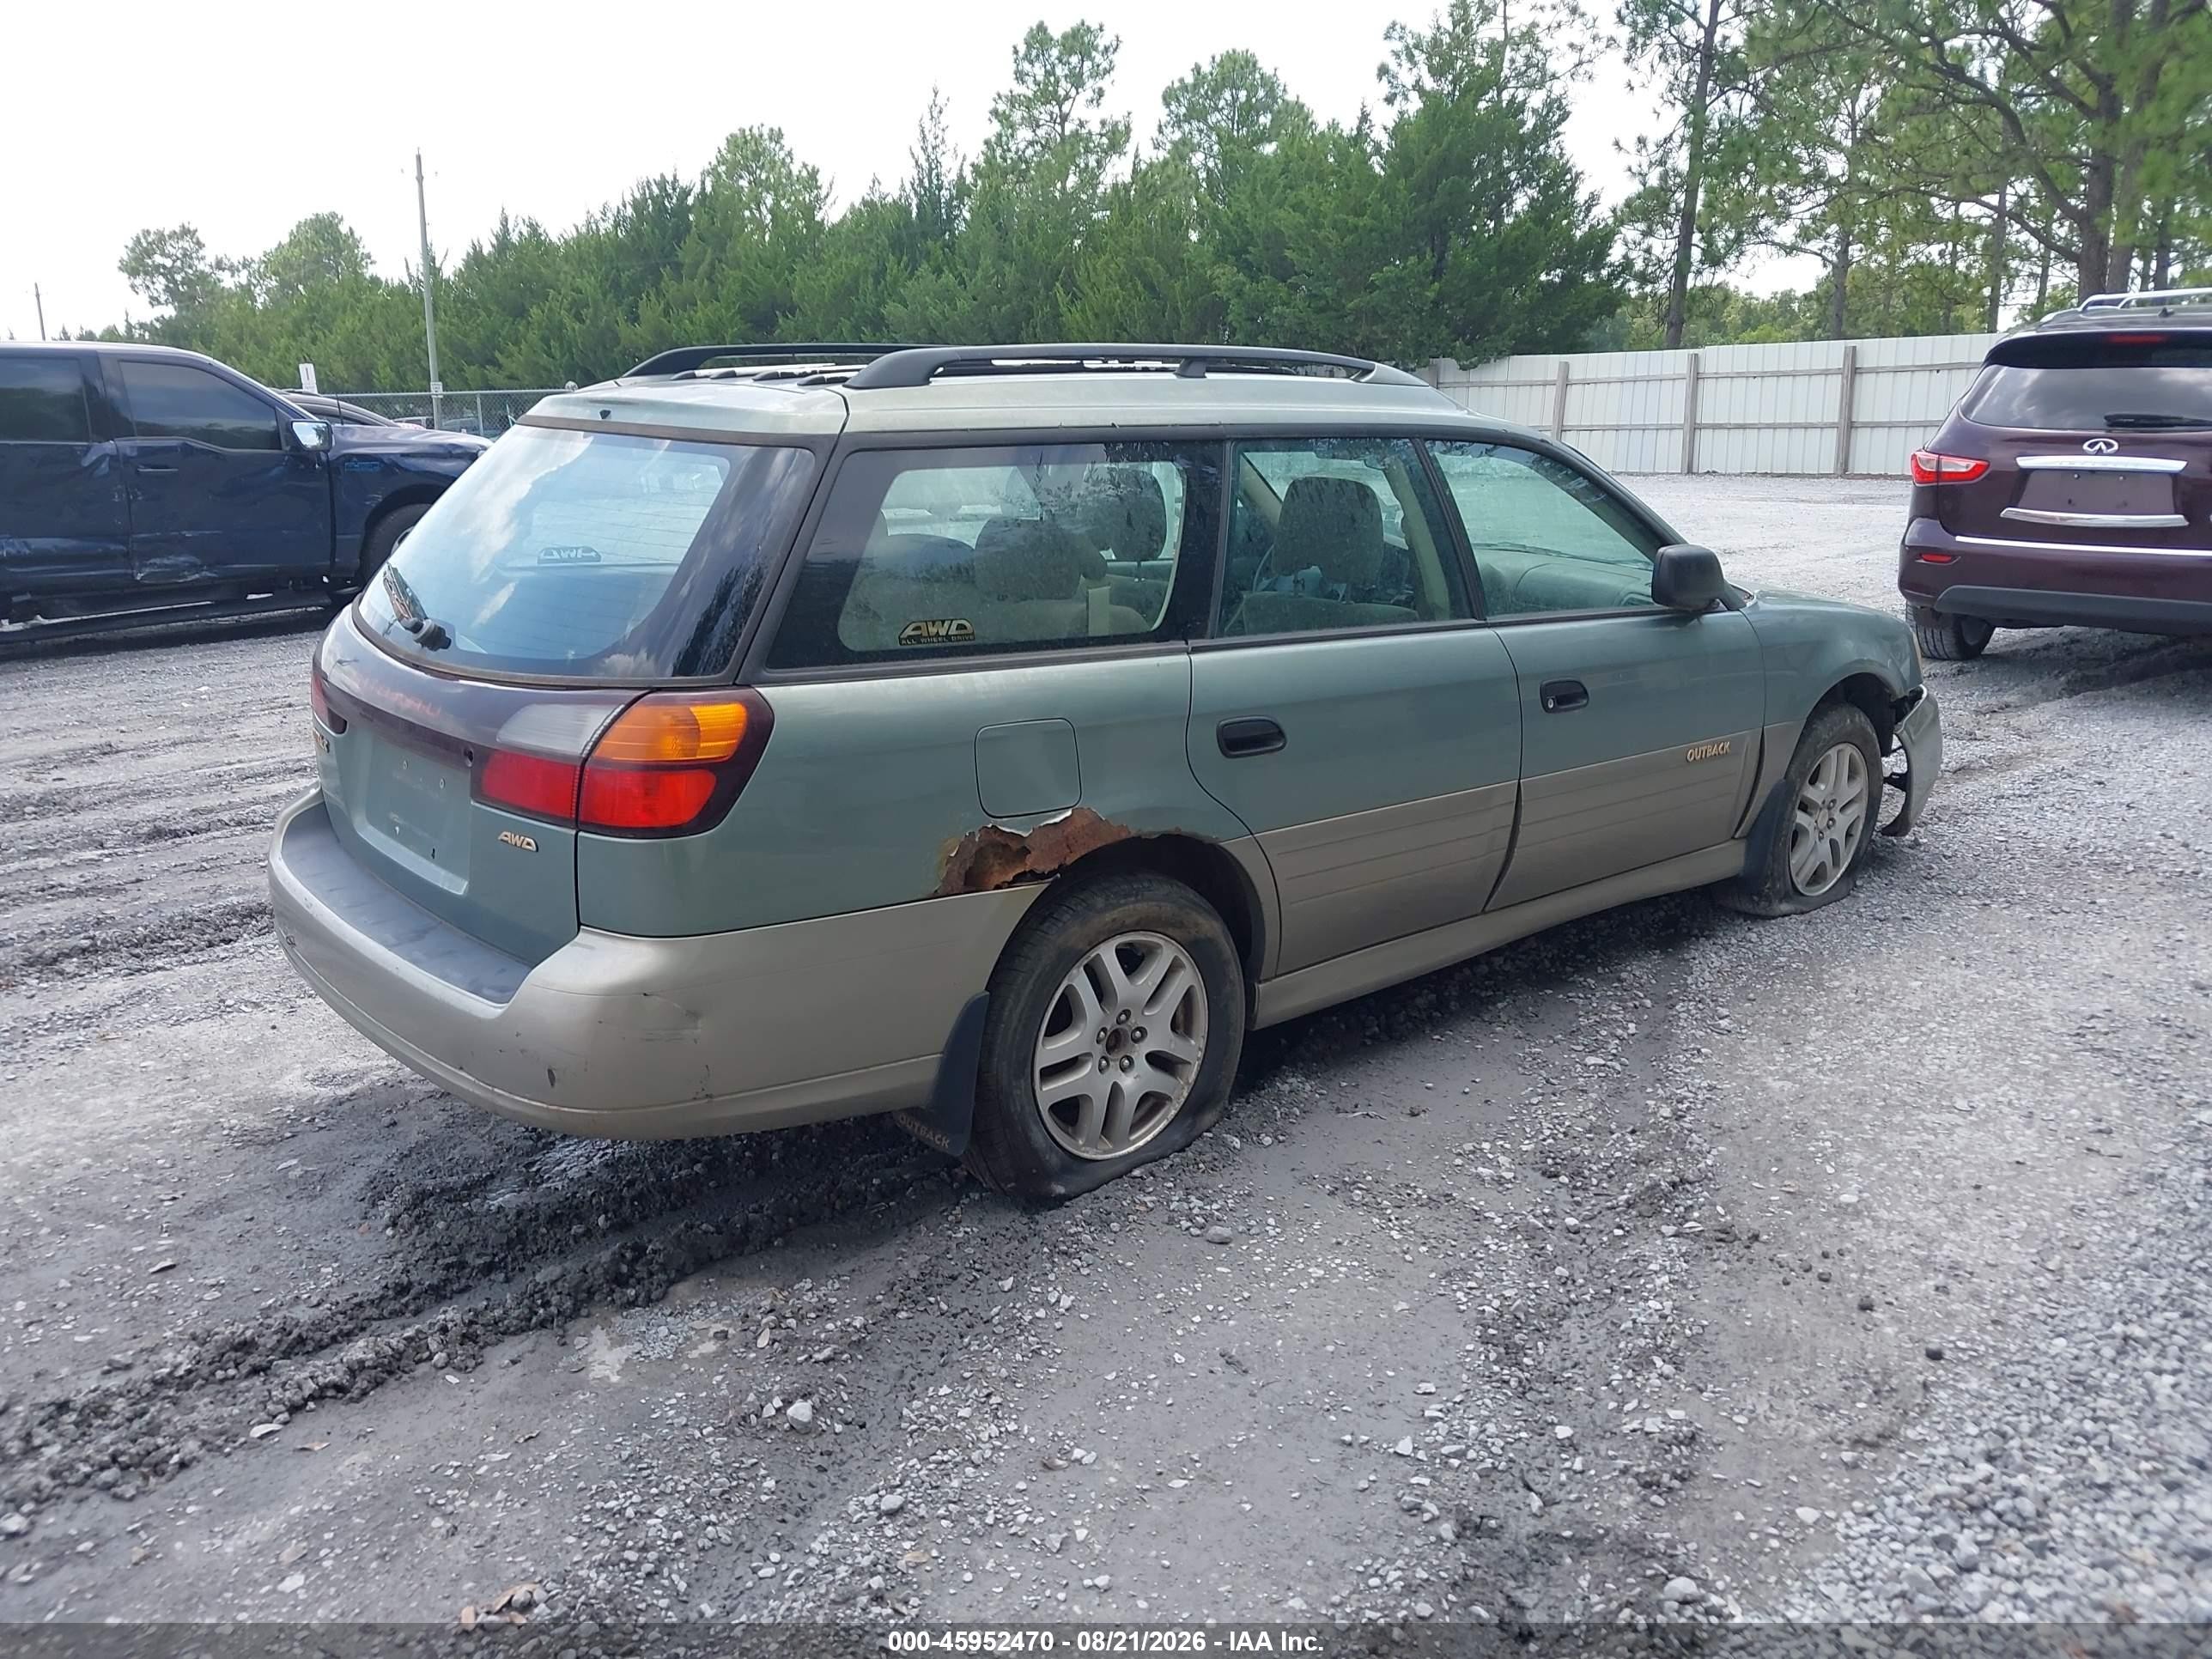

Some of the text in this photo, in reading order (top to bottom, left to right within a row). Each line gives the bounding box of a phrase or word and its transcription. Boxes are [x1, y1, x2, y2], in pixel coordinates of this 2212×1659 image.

[899, 618, 975, 638] AWD
[921, 636, 949, 645] WHEEL
[1686, 741, 1731, 763] OUTBACK
[497, 830, 538, 852] AWD
[898, 1113, 951, 1150] OUTBACK
